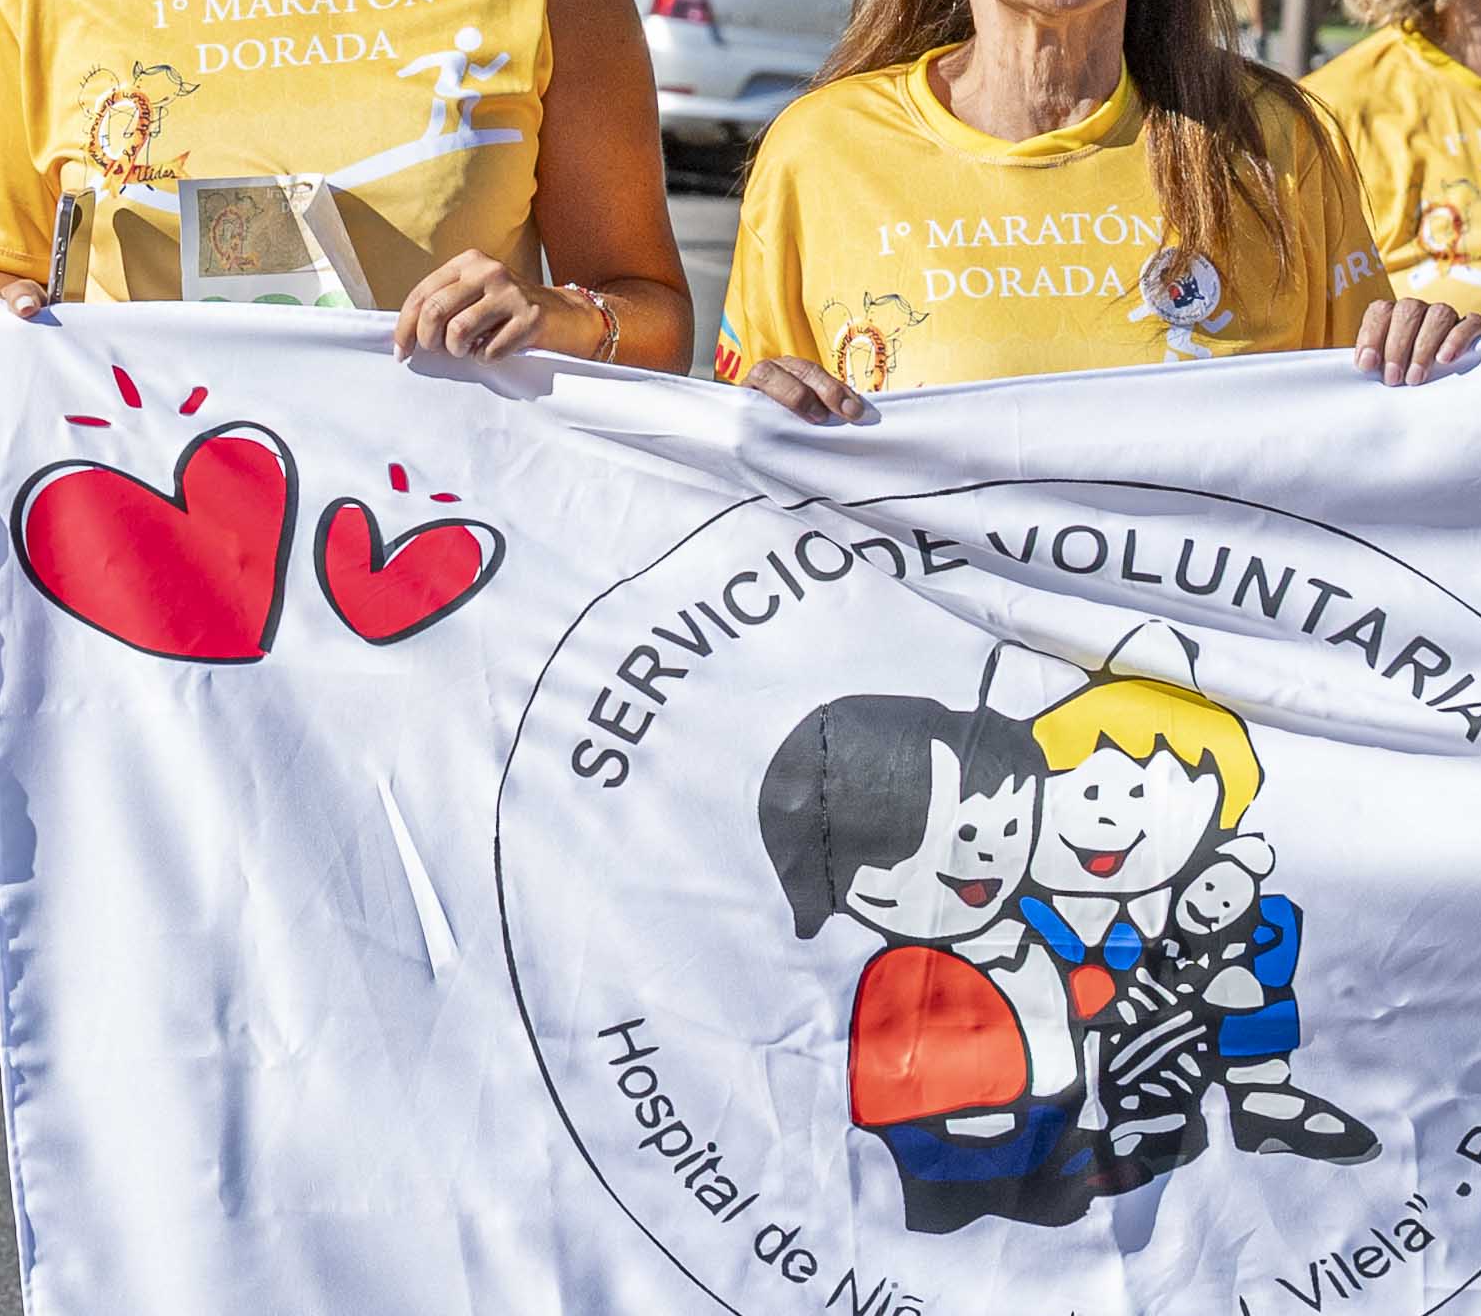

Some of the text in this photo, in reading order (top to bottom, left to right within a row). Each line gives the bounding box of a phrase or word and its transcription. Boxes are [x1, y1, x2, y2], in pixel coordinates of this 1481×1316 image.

[195, 29, 400, 75] DORADA
[926, 204, 1163, 250] MARATÓN
[921, 264, 1126, 304] DORADA
[571, 530, 854, 789] SERVICIO
[850, 528, 970, 581] DE
[598, 1017, 753, 1224] Hospital
[753, 1222, 817, 1284] de
